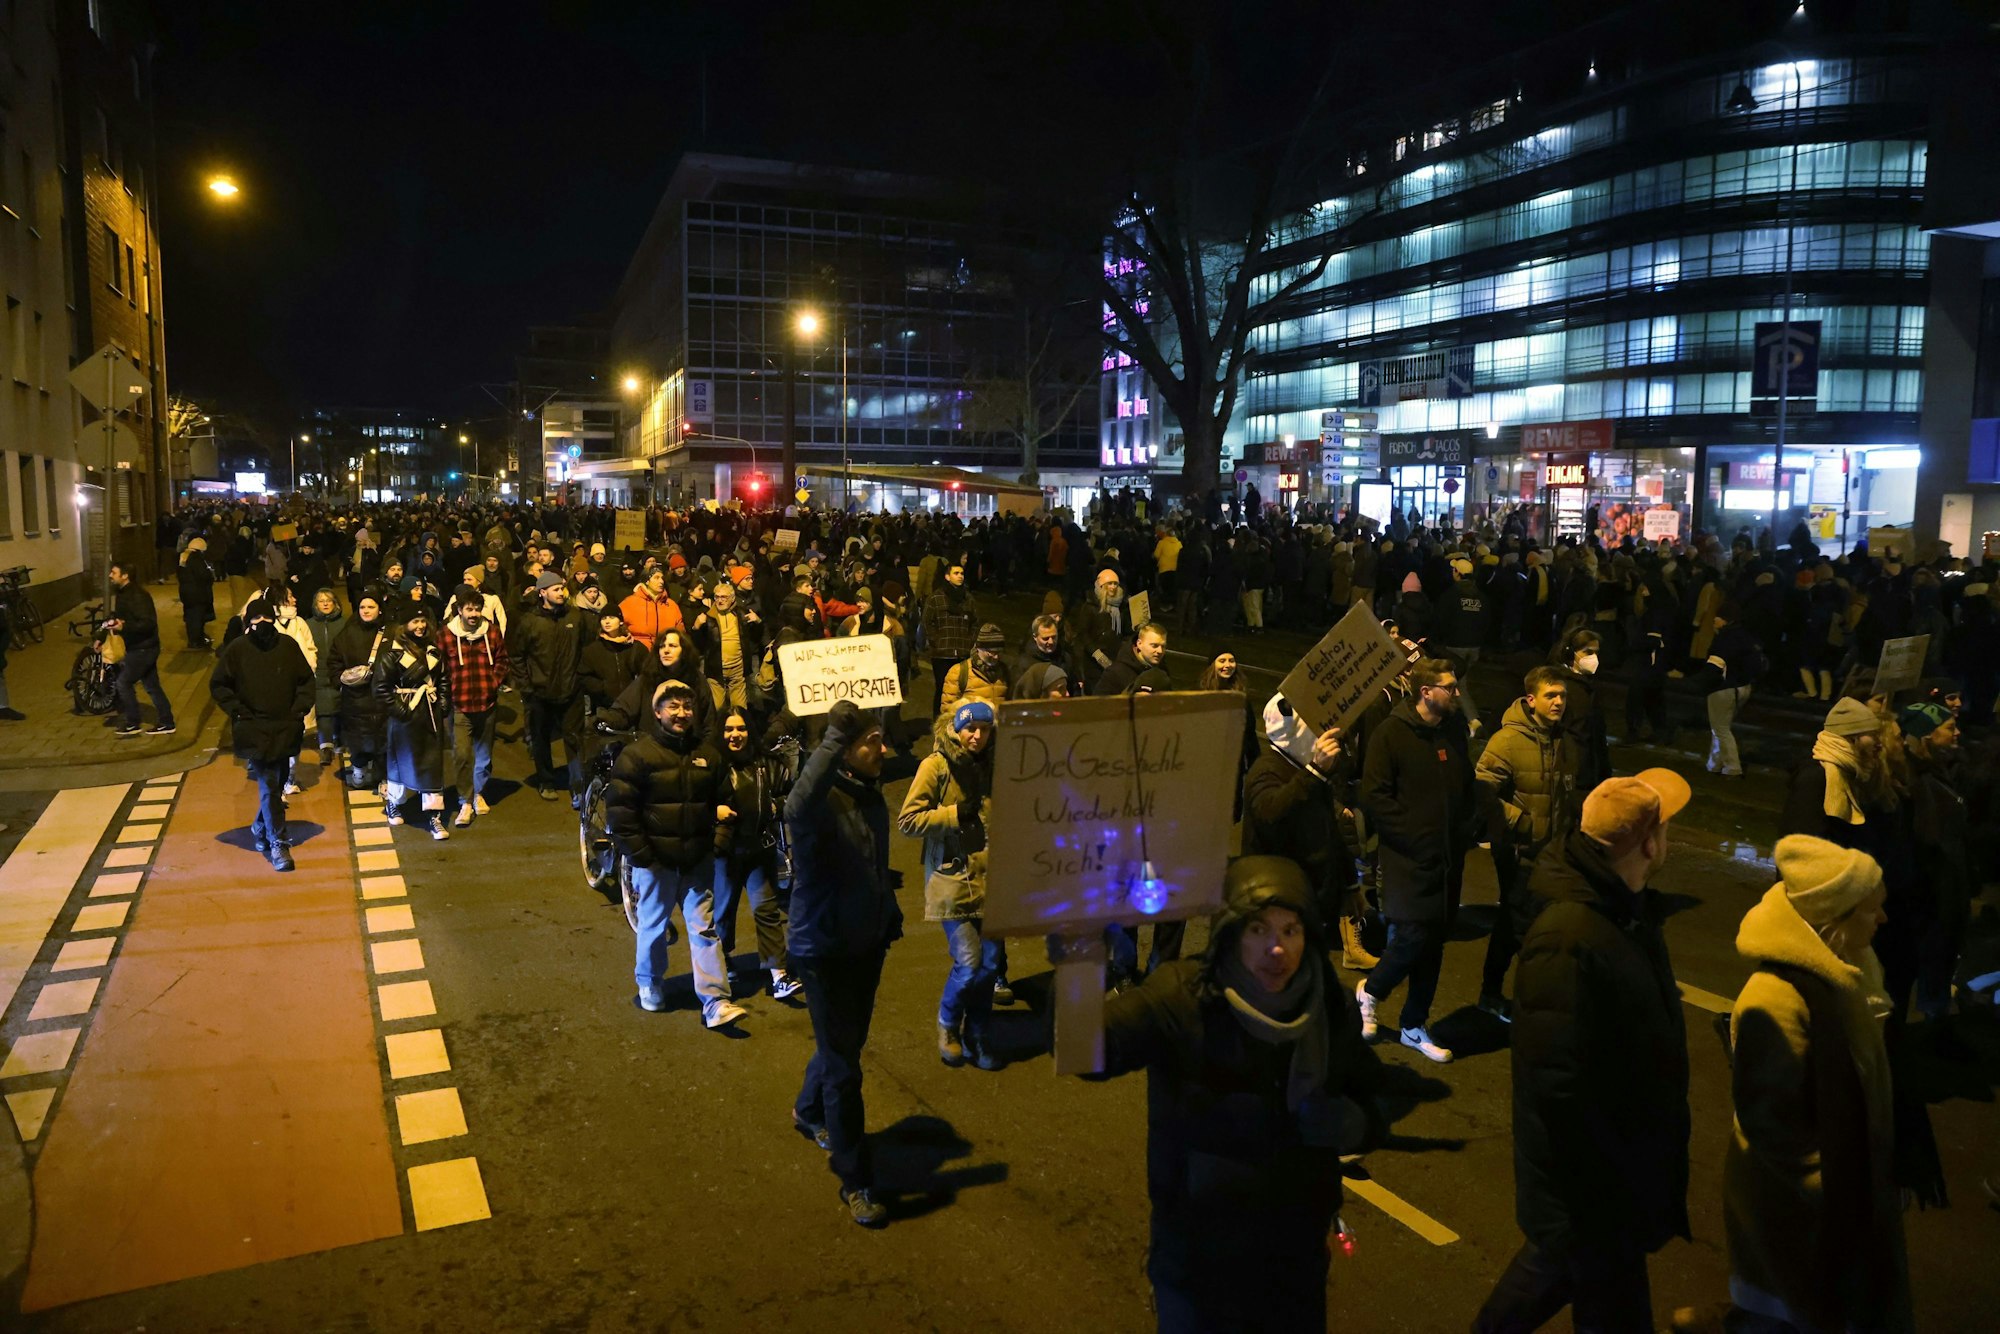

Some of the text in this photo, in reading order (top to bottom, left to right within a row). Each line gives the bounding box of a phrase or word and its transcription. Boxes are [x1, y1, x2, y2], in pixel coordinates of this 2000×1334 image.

[1389, 439, 1460, 454] FRENCH TACOS
[1524, 427, 1574, 449] REWE
[1265, 446, 1294, 462] REWE
[1546, 465, 1586, 484] EINGANG
[1740, 464, 1776, 479] REWE
[794, 644, 872, 662] WIR KÄMPFEN
[1307, 640, 1345, 680] destroy
[821, 667, 839, 675] FÜR
[1317, 691, 1331, 704] be
[1331, 674, 1347, 690] like
[1353, 641, 1378, 671] panda
[1321, 644, 1356, 685] racism!
[1337, 685, 1362, 713] black
[1363, 668, 1378, 689] and
[1378, 651, 1396, 671] white
[1009, 733, 1067, 783] Die
[1030, 843, 1107, 878] Sich!
